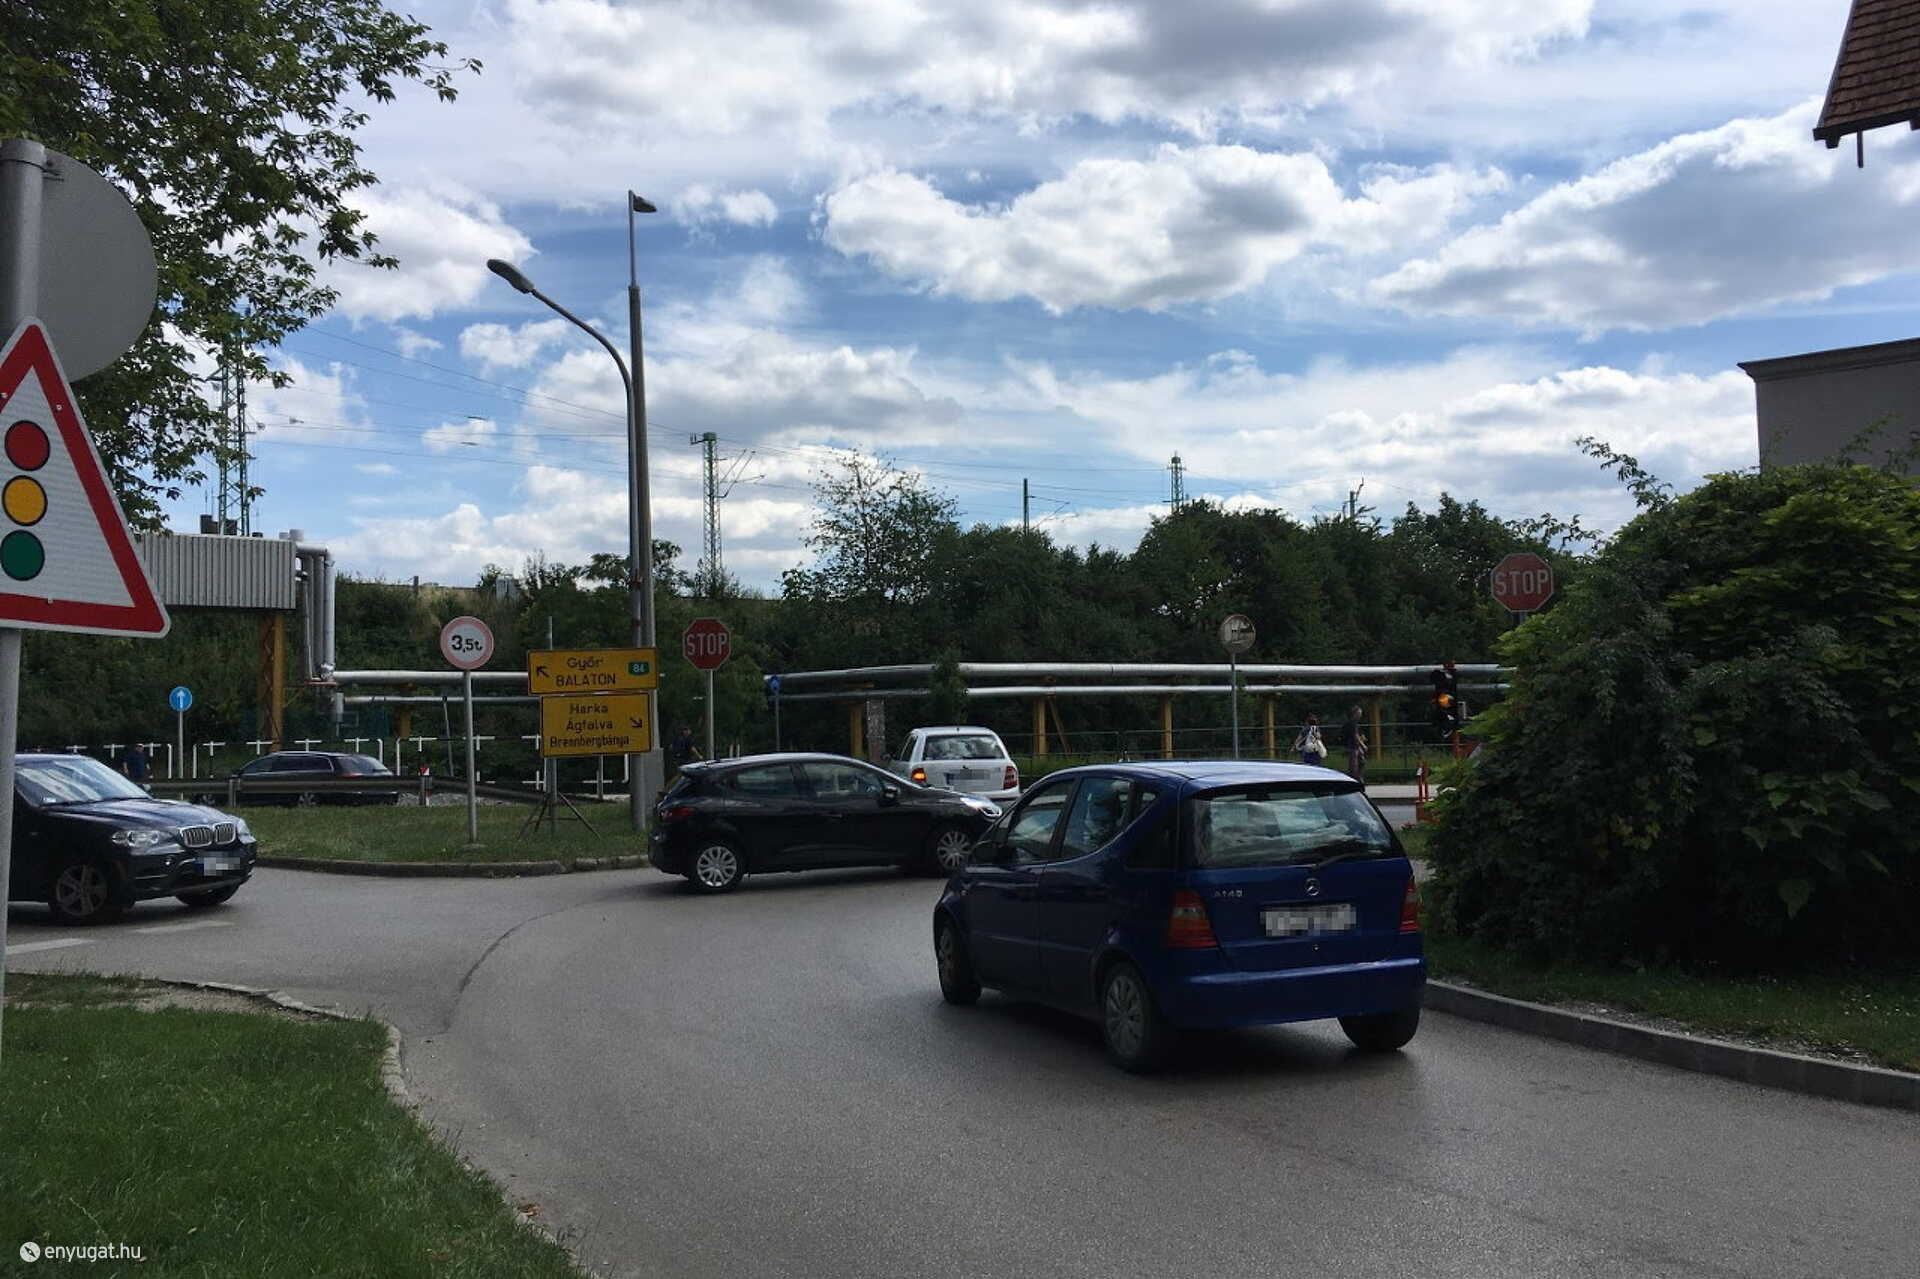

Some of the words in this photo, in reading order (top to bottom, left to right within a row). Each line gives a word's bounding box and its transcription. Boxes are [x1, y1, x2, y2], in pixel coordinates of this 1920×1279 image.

[1495, 569, 1549, 596] STOP
[451, 635, 483, 653] 3,5t
[686, 632, 728, 656] STOP
[566, 656, 604, 672] Győr
[631, 663, 645, 673] 84
[555, 673, 616, 687] BALATON
[569, 703, 608, 714] Harka
[566, 717, 613, 733] Ágfalva
[550, 734, 630, 747] Brennbergbánya
